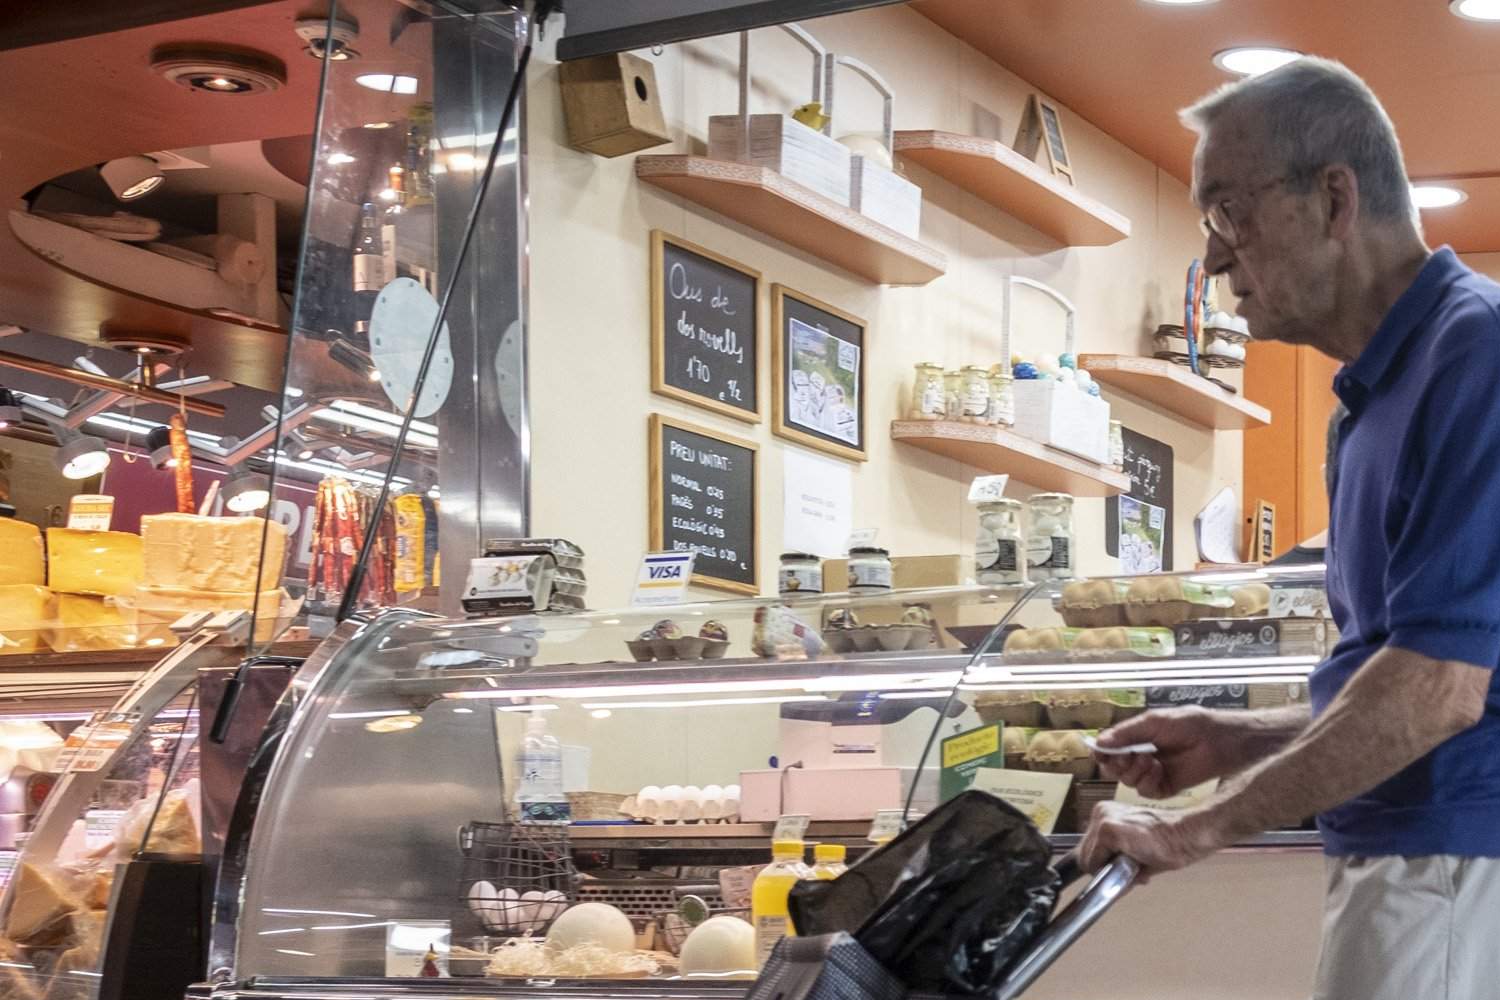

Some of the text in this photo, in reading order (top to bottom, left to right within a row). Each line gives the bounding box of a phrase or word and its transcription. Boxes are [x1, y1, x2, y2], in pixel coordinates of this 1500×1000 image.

[711, 285, 735, 316] de
[669, 440, 695, 463] PREU
[648, 566, 682, 579] VISA
